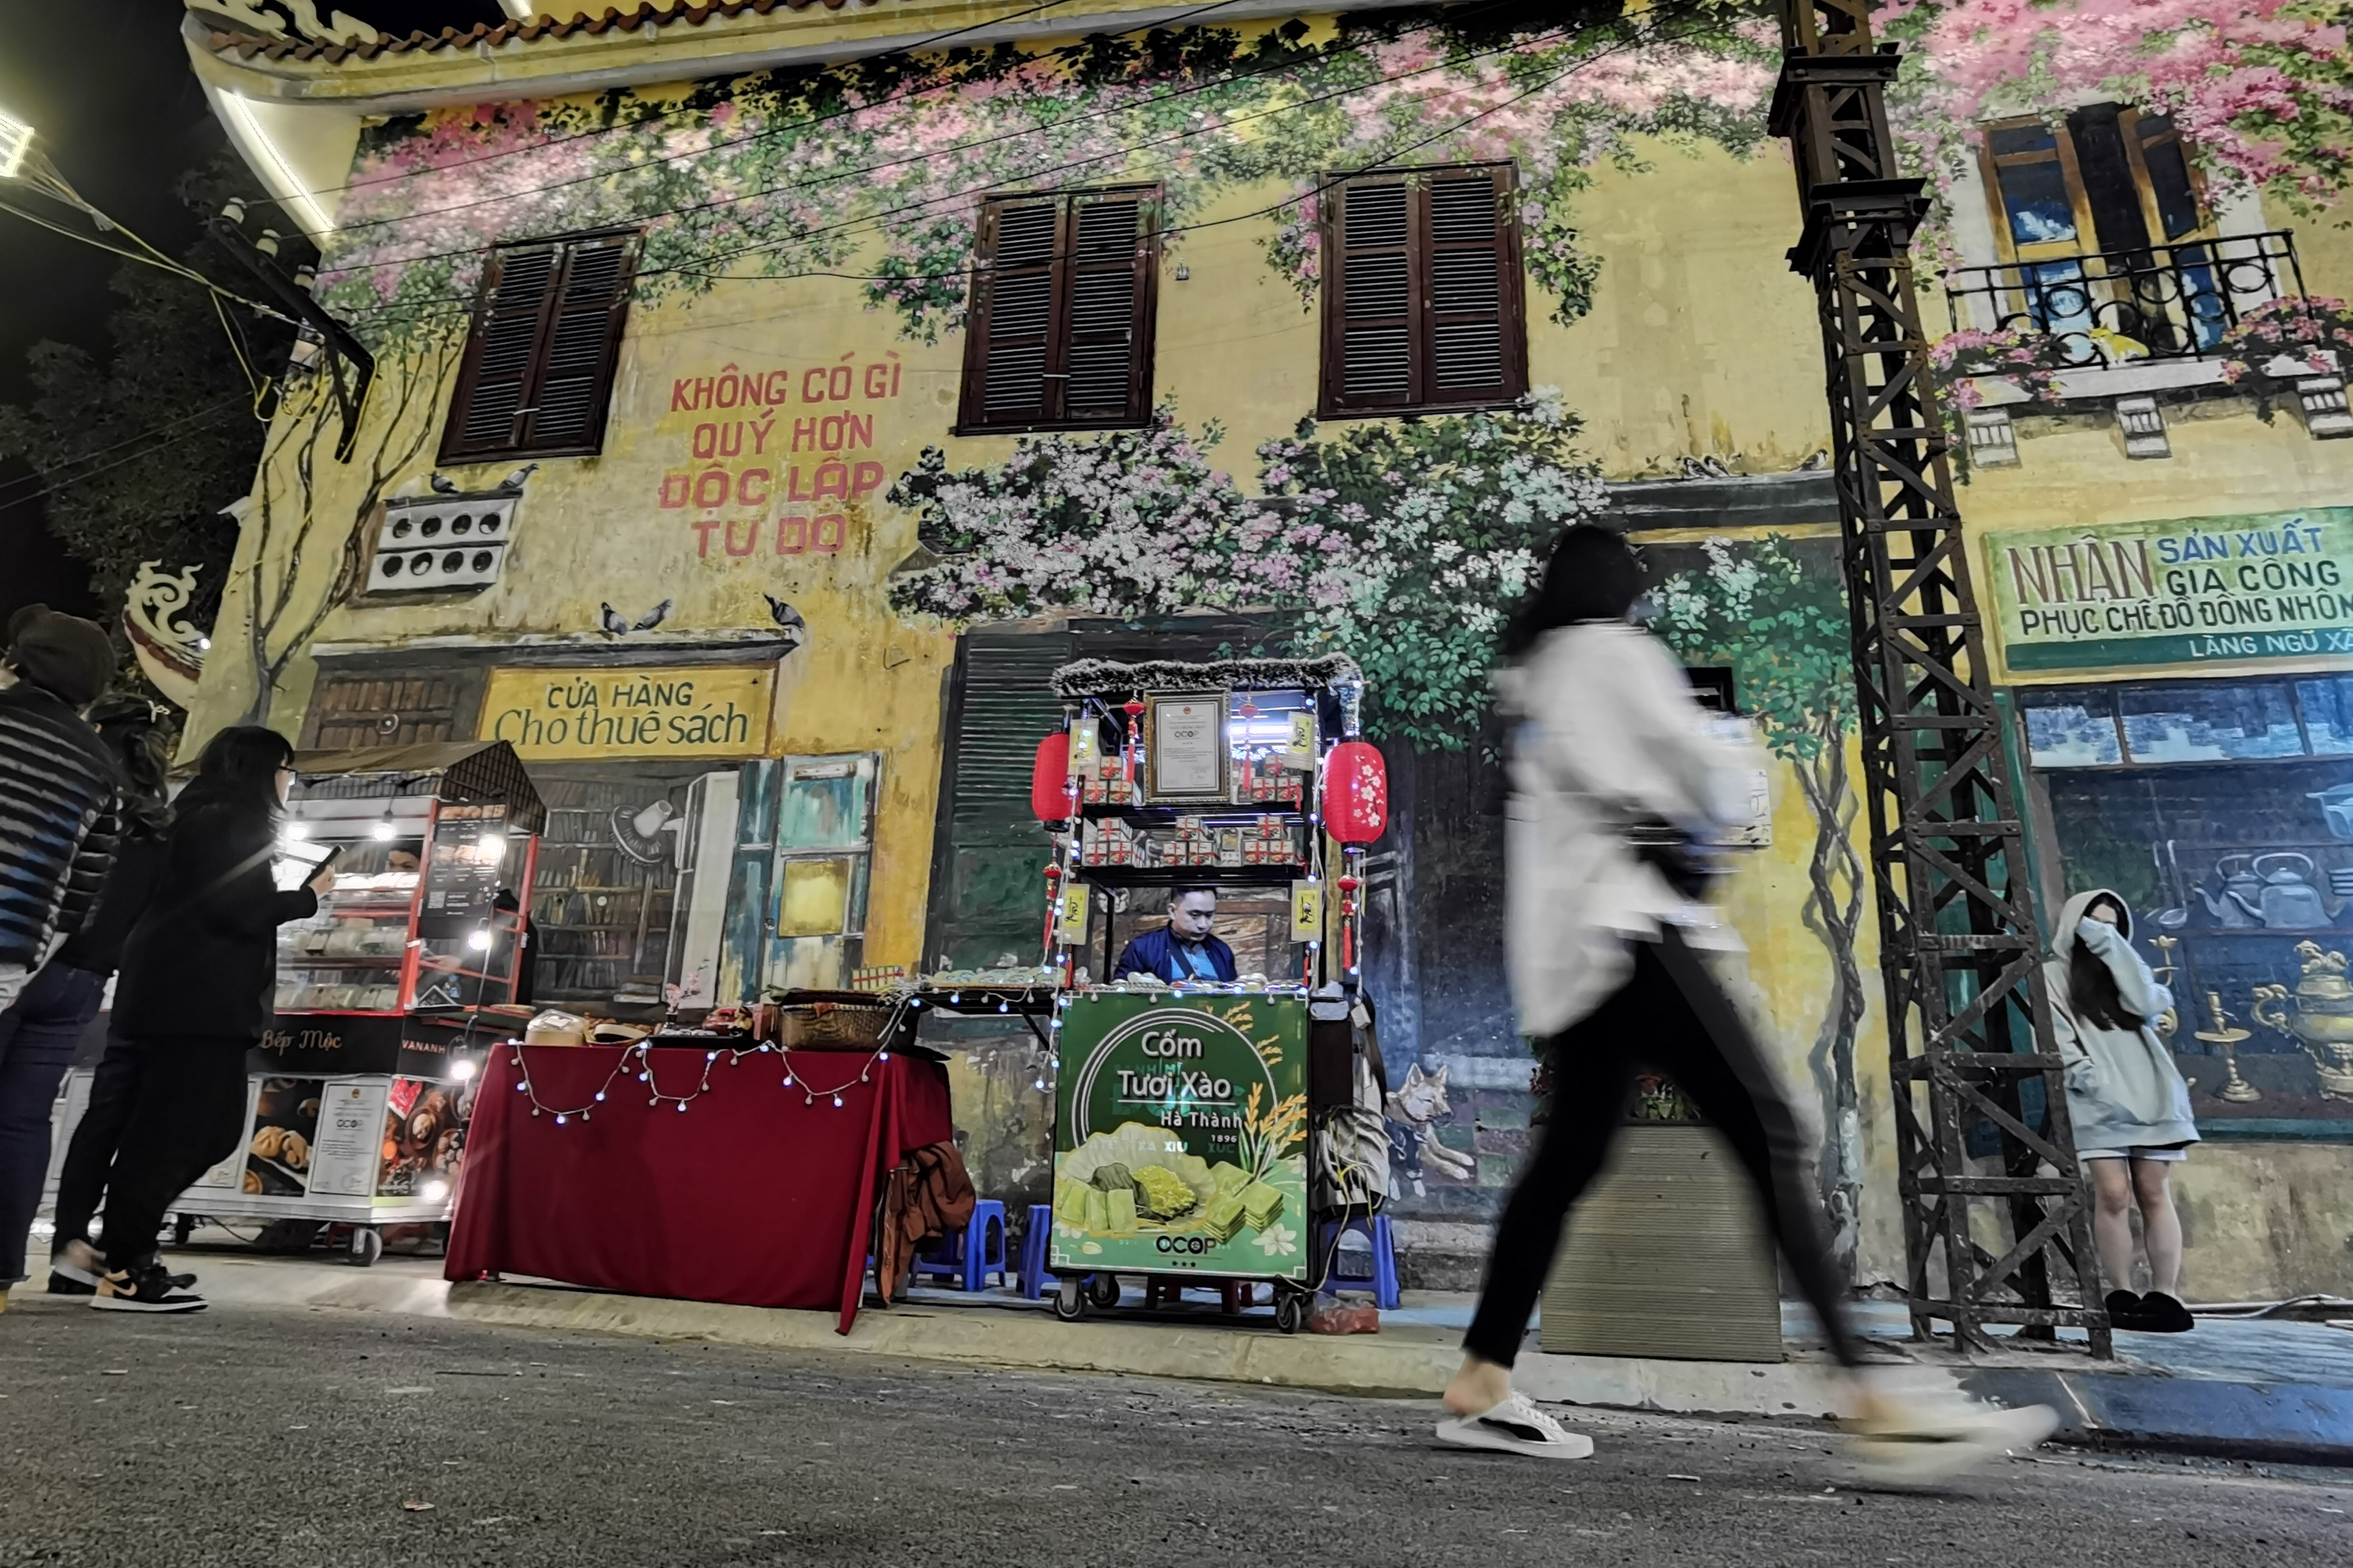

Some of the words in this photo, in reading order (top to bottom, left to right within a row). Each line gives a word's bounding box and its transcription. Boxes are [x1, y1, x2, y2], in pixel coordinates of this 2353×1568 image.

[670, 362, 788, 412] KHÔNG
[802, 350, 855, 403] CÓ
[865, 350, 901, 399] GÌ
[692, 407, 776, 459] QUÝ
[791, 410, 873, 453] HƠN
[658, 462, 770, 516] ĐỘC
[787, 455, 885, 508] LẬP
[777, 513, 847, 555] DO
[2007, 534, 2155, 604] NHẬN
[2157, 527, 2229, 563] SẢN
[2235, 517, 2322, 558] XUẤT
[2166, 568, 2228, 596] GIA
[2238, 557, 2340, 592] CÔNG
[2020, 607, 2100, 639] PHỤC
[2158, 596, 2194, 629] ĐỒ
[2197, 592, 2273, 627] ĐỒNG
[2189, 634, 2258, 657] LÀNG
[2265, 629, 2319, 652] NGŨ
[547, 675, 598, 709] CỬA
[612, 675, 694, 708] HÀNG
[494, 708, 568, 746] Cho
[576, 708, 661, 744] thuê
[667, 702, 747, 744] sách
[260, 1029, 295, 1057] Bếp
[298, 1029, 343, 1052] Mộc
[1141, 1028, 1202, 1057] Cốm
[1117, 1069, 1172, 1097] Tươi
[1181, 1071, 1232, 1099] Xào
[1160, 1110, 1183, 1127] Hà
[1189, 1111, 1243, 1129] Thành
[1210, 1134, 1238, 1143] 1896
[1156, 1235, 1217, 1255] OCOP
